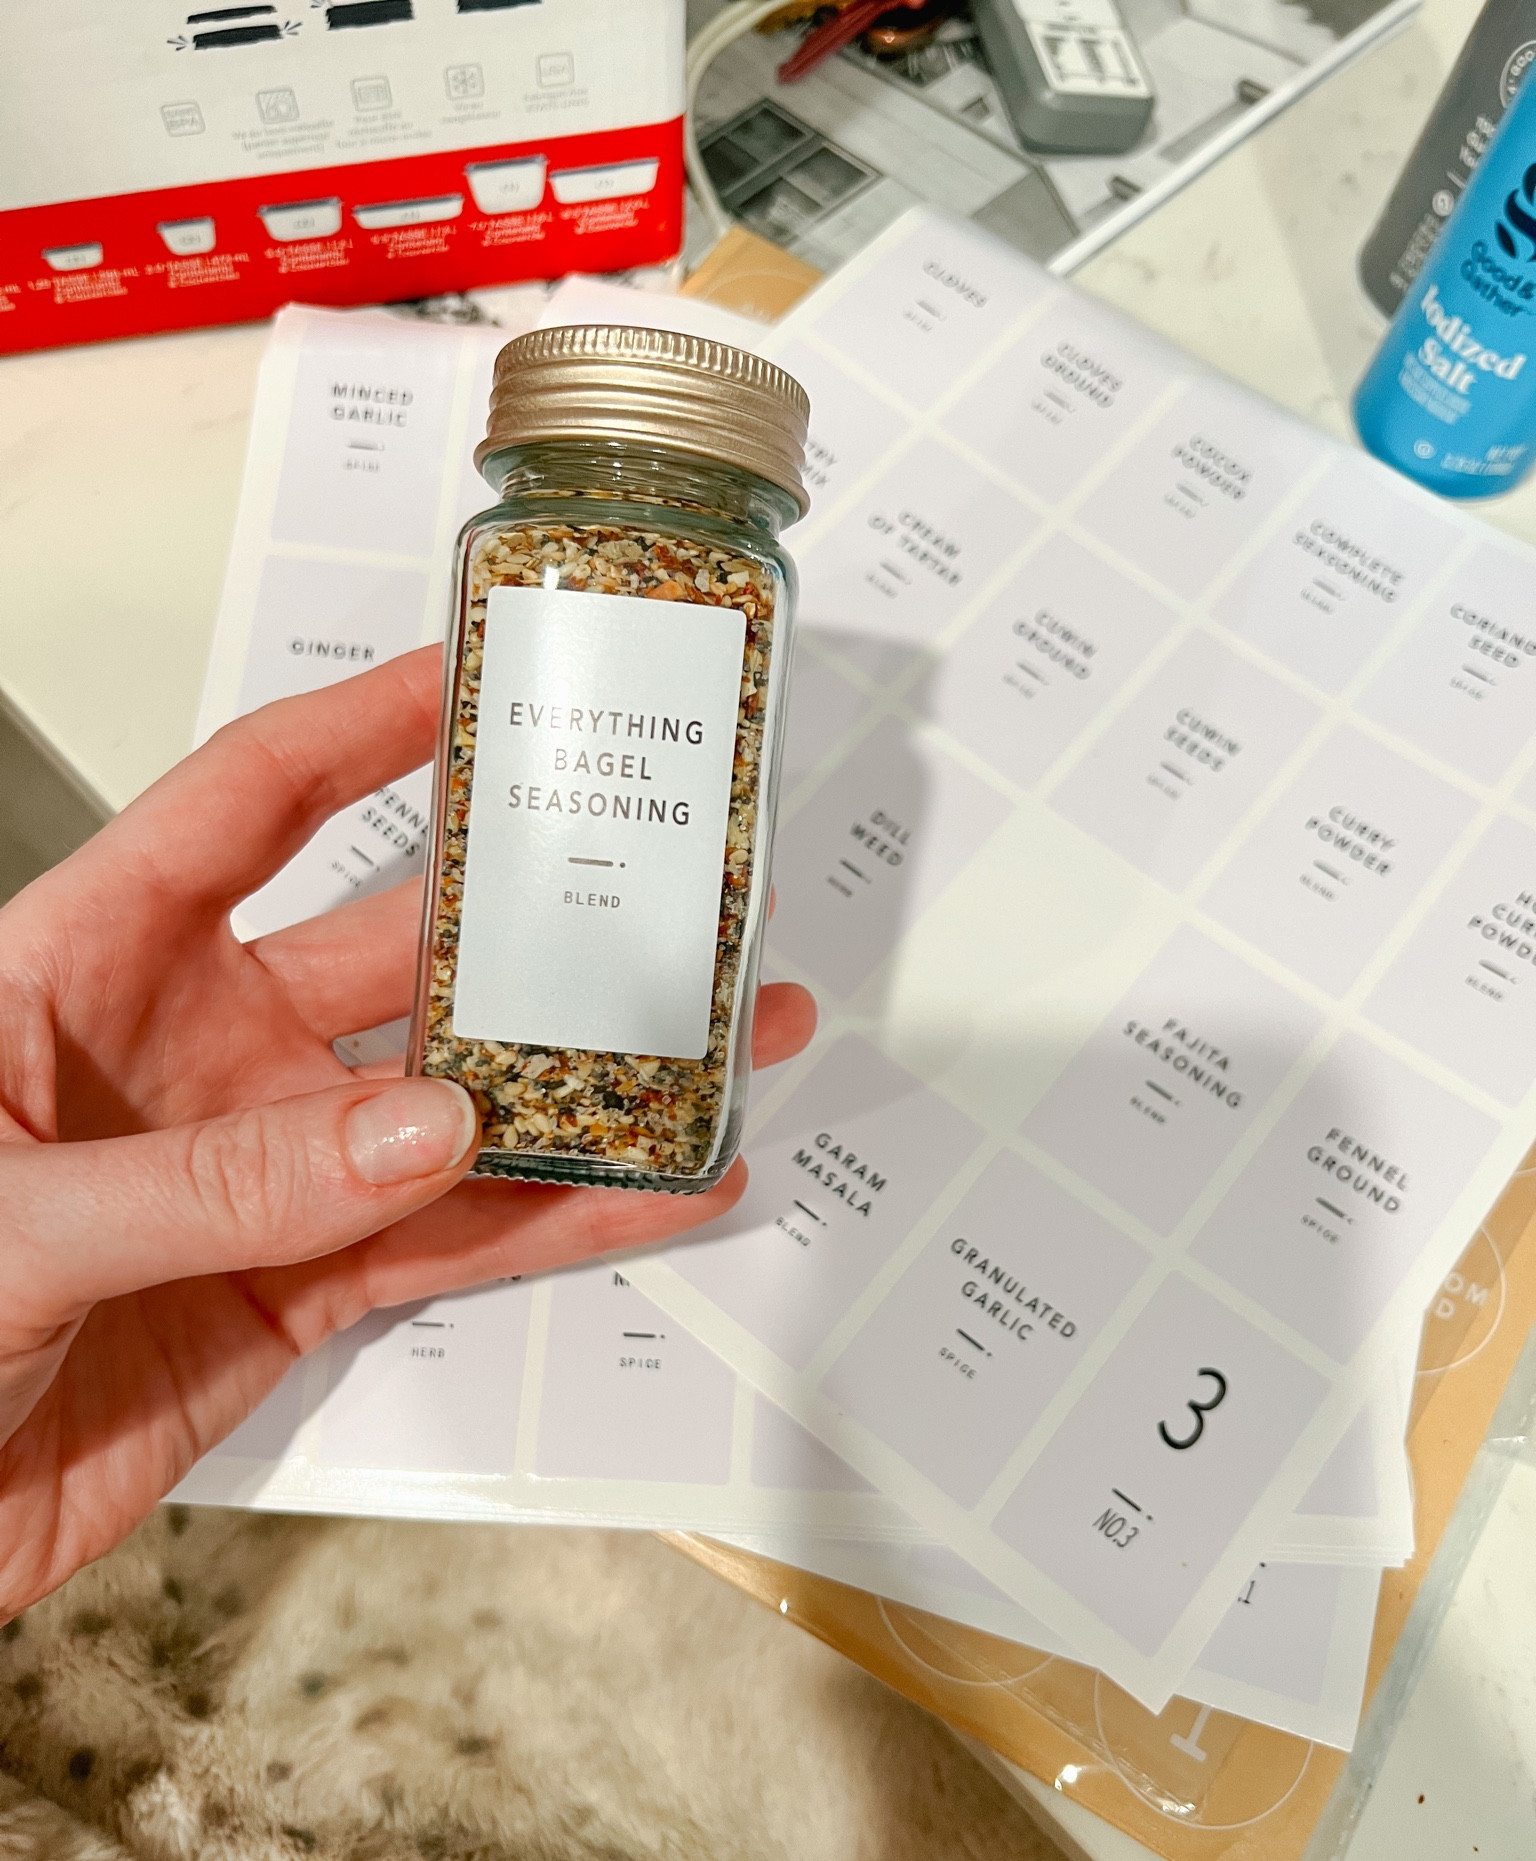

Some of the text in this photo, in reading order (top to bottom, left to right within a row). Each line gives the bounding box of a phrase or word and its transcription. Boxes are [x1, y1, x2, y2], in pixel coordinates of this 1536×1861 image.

[923, 260, 987, 308] CLOVES
[1461, 259, 1523, 317] Gather
[1471, 239, 1523, 292] Good
[1420, 285, 1526, 380] Iodized
[1040, 351, 1114, 409] GROUND
[1057, 340, 1123, 393] CLOVES
[1418, 336, 1476, 395] Salt
[330, 405, 408, 428] GARLIC
[331, 382, 414, 406] MINCED
[1171, 443, 1246, 501] POWDER
[899, 510, 961, 560] CREAM
[899, 534, 962, 586] TARTAR
[1310, 518, 1404, 585] COMPLETE
[1292, 529, 1397, 603] SEASONING
[289, 637, 375, 661] GINGER
[1012, 619, 1091, 680] GROUND
[1034, 608, 1098, 659] CUMIN
[1468, 634, 1520, 668] SEED
[509, 702, 704, 745] EVERYTHING
[1163, 724, 1225, 773] SEEDS
[1176, 707, 1242, 757] CUMIN
[554, 748, 653, 781] BAGEL
[508, 784, 690, 826] SEASONING
[870, 810, 911, 846] DILL
[1328, 806, 1396, 851] CURRY
[362, 807, 420, 857] SEEDS
[850, 822, 903, 866] WEED
[1304, 816, 1391, 877] POWDER
[563, 891, 621, 909] BLEND
[1123, 1020, 1243, 1108] SEASONING
[1162, 1018, 1229, 1071] FAJITA
[792, 1149, 872, 1216] MASALA
[815, 1133, 887, 1192] GARAM
[1307, 1146, 1400, 1212] GROUND
[1325, 1128, 1408, 1191] FENNEL
[776, 1217, 811, 1246] BLEND
[951, 1238, 1077, 1338] GRANULATED
[961, 1281, 1034, 1340] GARLIC
[411, 1347, 445, 1358] HERB
[619, 1357, 663, 1369] SPICE
[939, 1347, 977, 1379] SPICE
[1157, 1367, 1227, 1449] 3
[1092, 1508, 1139, 1547] NO.3
